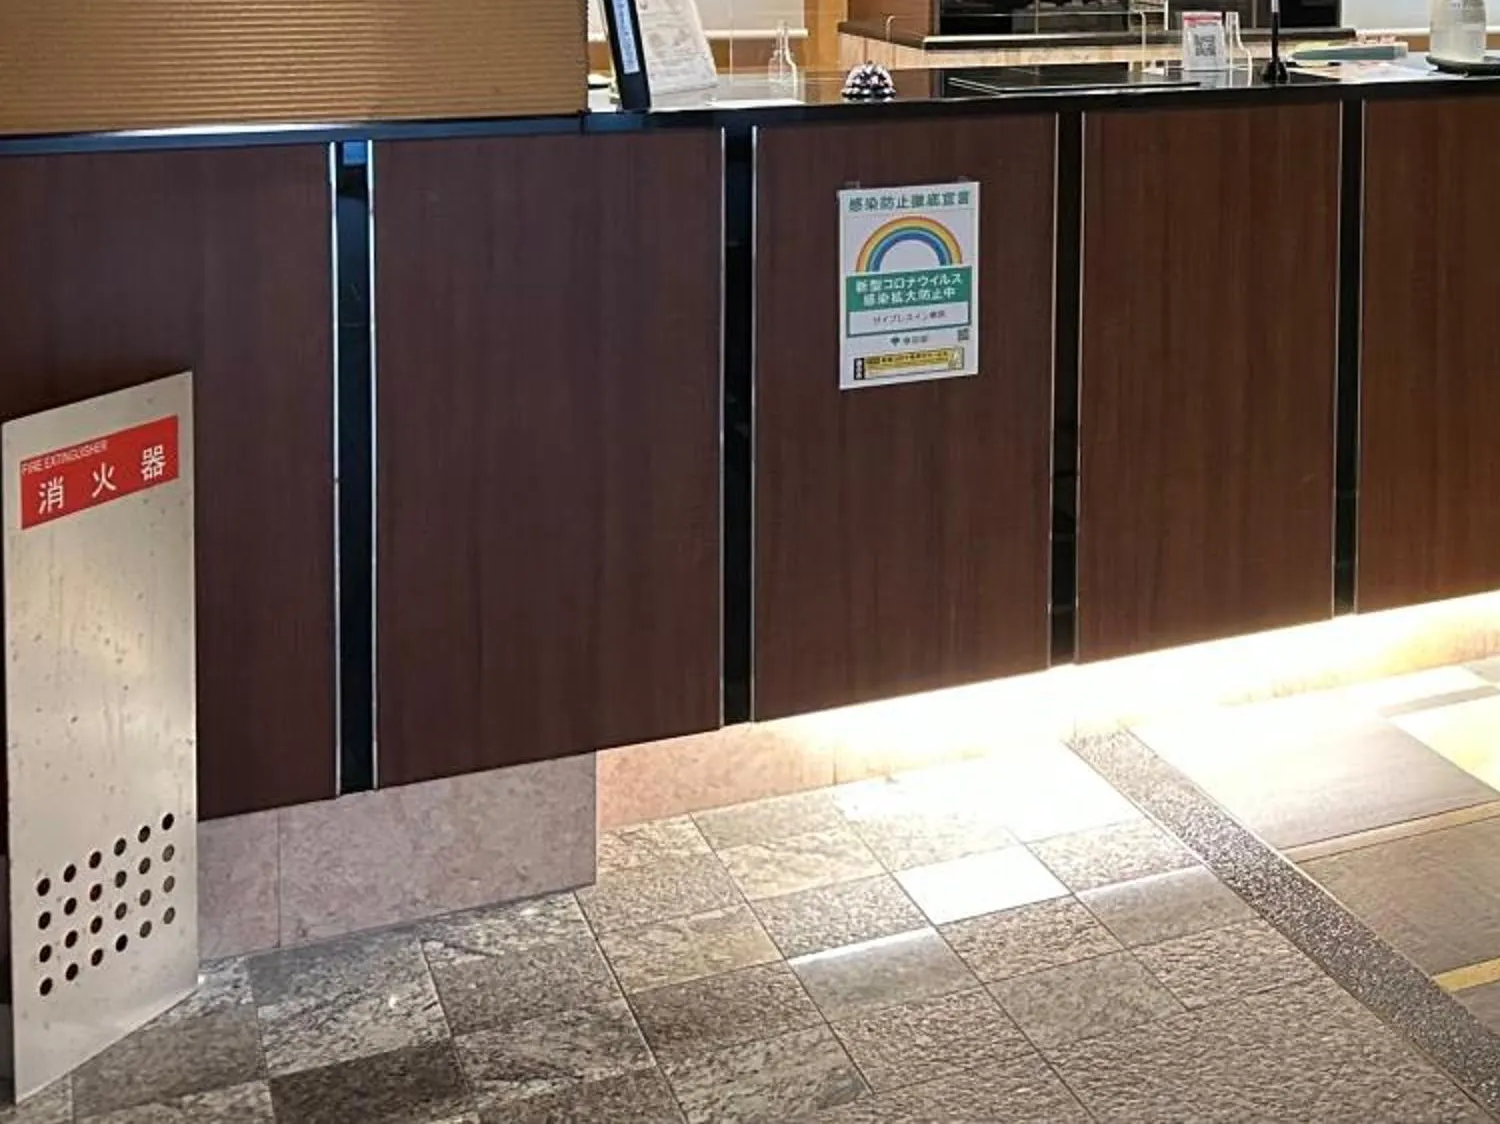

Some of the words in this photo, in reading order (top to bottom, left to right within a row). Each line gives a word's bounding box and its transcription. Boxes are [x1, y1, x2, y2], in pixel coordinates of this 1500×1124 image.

[22, 460, 43, 476] FIRE
[44, 440, 109, 469] EXTINGUISHER
[38, 444, 167, 514] 消火器
